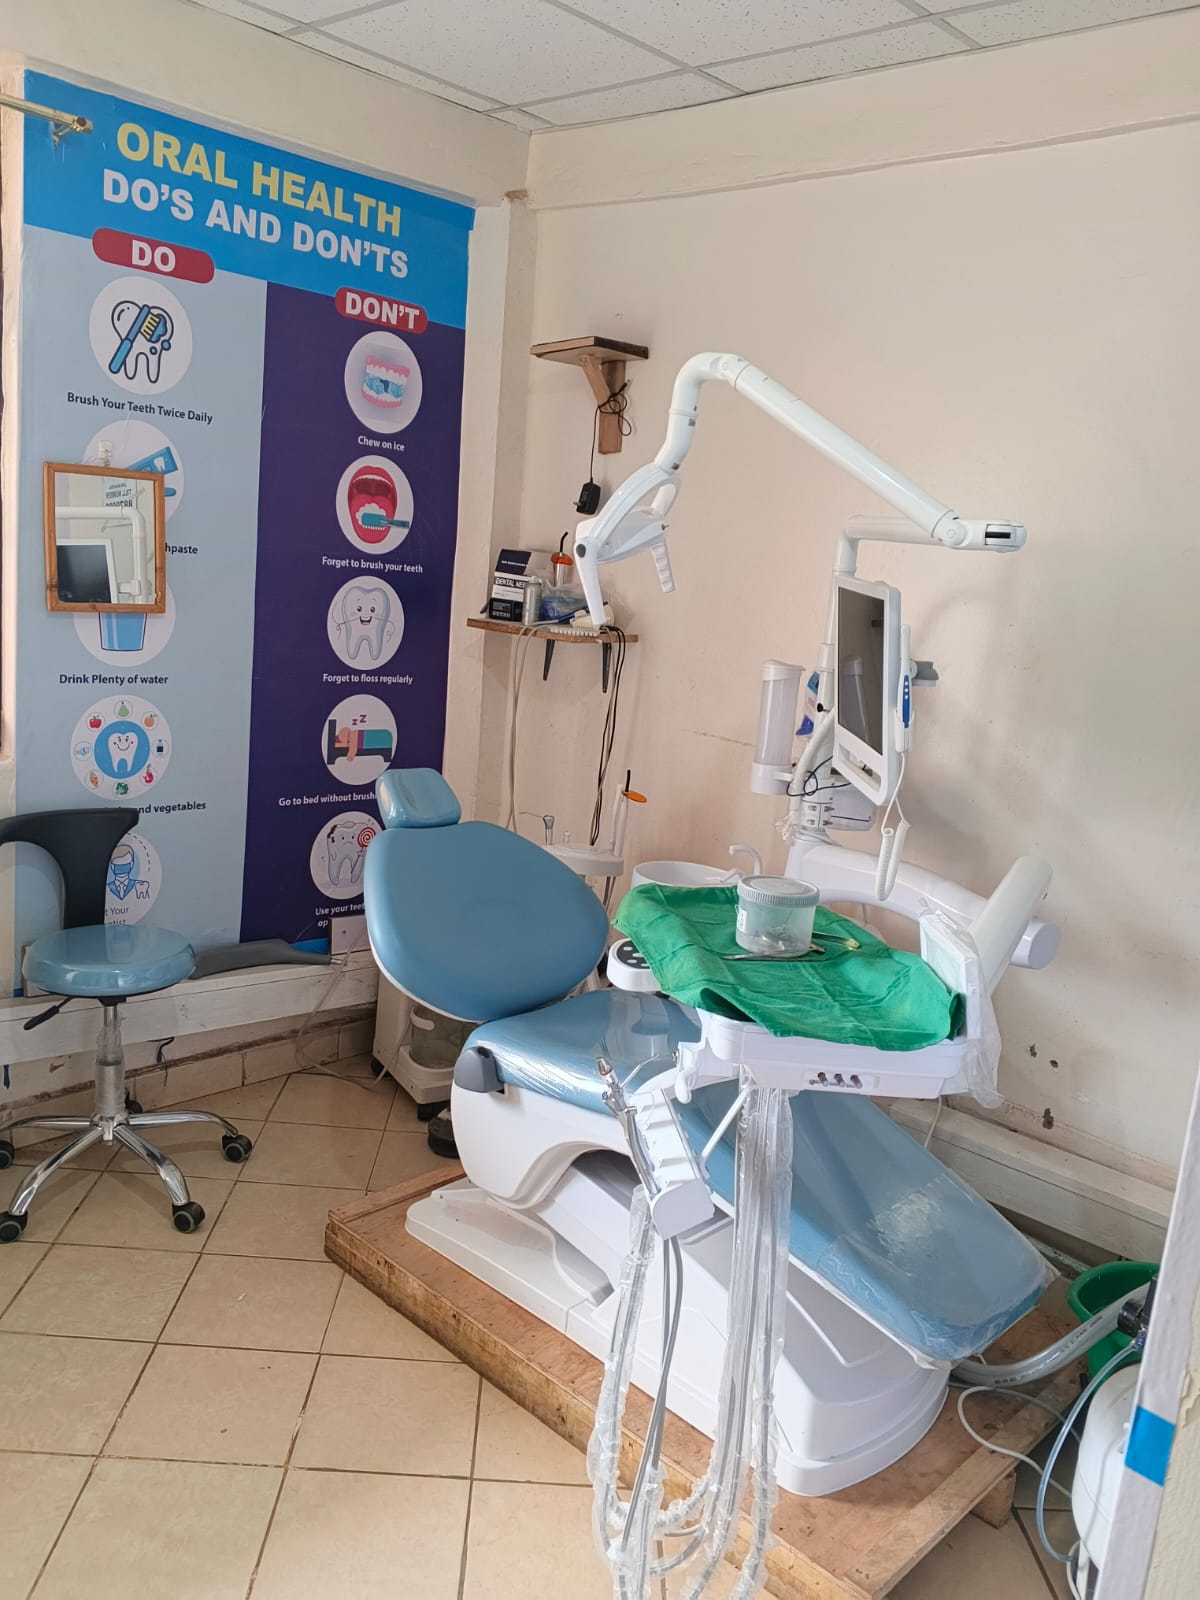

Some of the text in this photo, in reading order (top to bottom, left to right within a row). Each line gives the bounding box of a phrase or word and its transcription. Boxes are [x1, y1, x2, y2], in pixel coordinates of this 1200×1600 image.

[117, 122, 401, 238] ORAL HEALTH
[205, 198, 282, 244] AND
[132, 239, 176, 273] DO
[345, 291, 420, 329] DON'T
[67, 391, 213, 425] Brush Your Teeth Twice Daily
[357, 435, 405, 452] Chew on ice
[165, 542, 198, 555] hpaste
[322, 556, 423, 574] Forget to brush your teeth
[59, 674, 169, 687] Drink Plenty of water
[322, 673, 413, 686] Forget to floss regularly
[278, 797, 292, 807] Go
[292, 797, 302, 806] to
[303, 795, 319, 805] bed
[320, 793, 352, 804] without
[138, 801, 207, 815] nd vegetables
[110, 905, 130, 915] Your
[314, 907, 330, 916] Use
[330, 905, 349, 916] your
[317, 919, 329, 928] op
